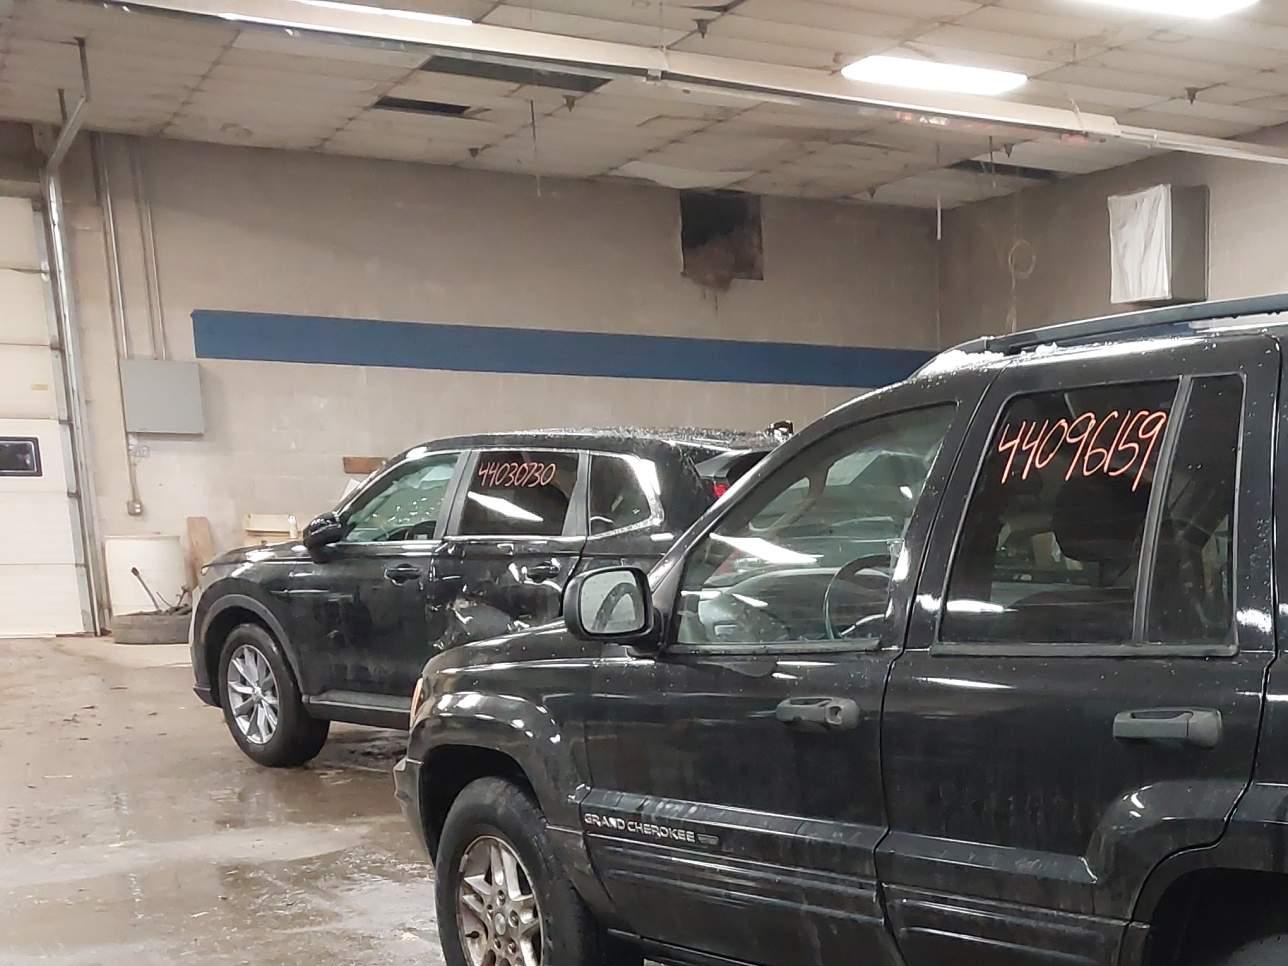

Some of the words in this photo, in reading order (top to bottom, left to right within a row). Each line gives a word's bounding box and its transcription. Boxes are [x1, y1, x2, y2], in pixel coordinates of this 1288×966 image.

[998, 409, 1168, 492] 44096159
[478, 461, 557, 488] 44030730
[584, 812, 626, 831] GRAND
[626, 820, 696, 844] CHEROKEE
